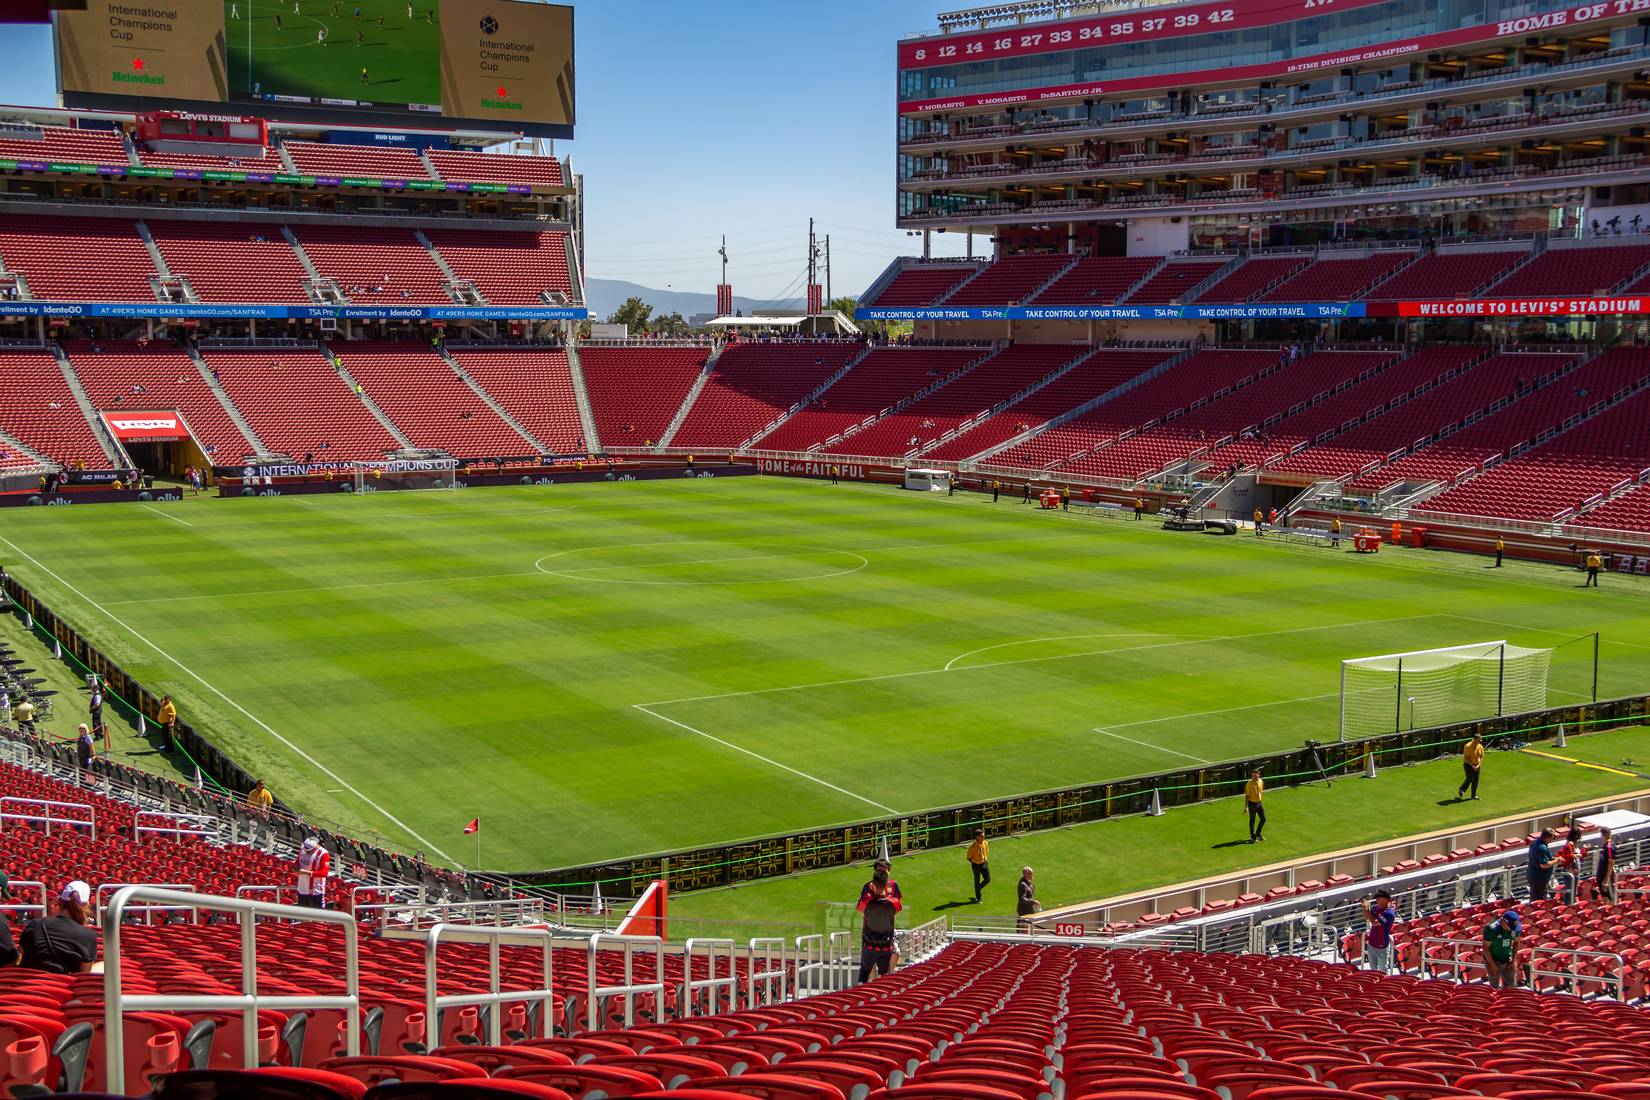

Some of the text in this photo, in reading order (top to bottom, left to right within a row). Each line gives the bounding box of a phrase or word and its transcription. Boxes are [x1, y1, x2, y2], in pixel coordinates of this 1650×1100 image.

[108, 4, 178, 20] International
[109, 16, 173, 32] Champions
[1496, 10, 1567, 35] HOME
[1574, 3, 1608, 21] OF
[110, 29, 133, 41] Cup
[915, 9, 1234, 60] 8 12 14 16 27 33 34 35 37 39 42
[479, 39, 534, 52] International
[480, 50, 530, 63] Champions
[1287, 44, 1419, 72] 19-TIME DIVISION CHAMPIONS
[480, 61, 499, 72] Cup
[112, 71, 166, 85] Heineken
[924, 101, 965, 111] MORABITO
[985, 95, 1027, 105] MORABITO
[209, 114, 242, 123] STADIUM
[29, 307, 38, 315] by
[43, 306, 82, 314] IdentoGO
[308, 308, 321, 316] TSA
[346, 309, 377, 317] Enrollment
[378, 309, 386, 318] by
[390, 309, 422, 317] IdentoGO
[1154, 309, 1166, 317] TSA
[1199, 307, 1305, 317] TAKE CONTROL OF YOUR TRAVEL
[1318, 307, 1330, 315] TSA
[1420, 303, 1484, 314] WELCOME
[1489, 303, 1506, 313] TO
[1570, 300, 1641, 312] STADIUM
[981, 310, 992, 318] TSA
[1025, 310, 1043, 318] TAKE
[1045, 310, 1077, 318] CONTROL
[1112, 309, 1140, 317] TRAVEL
[435, 459, 459, 470] CUP
[757, 459, 789, 473] HOME
[352, 864, 366, 877] 108
[1056, 923, 1082, 935] 106
